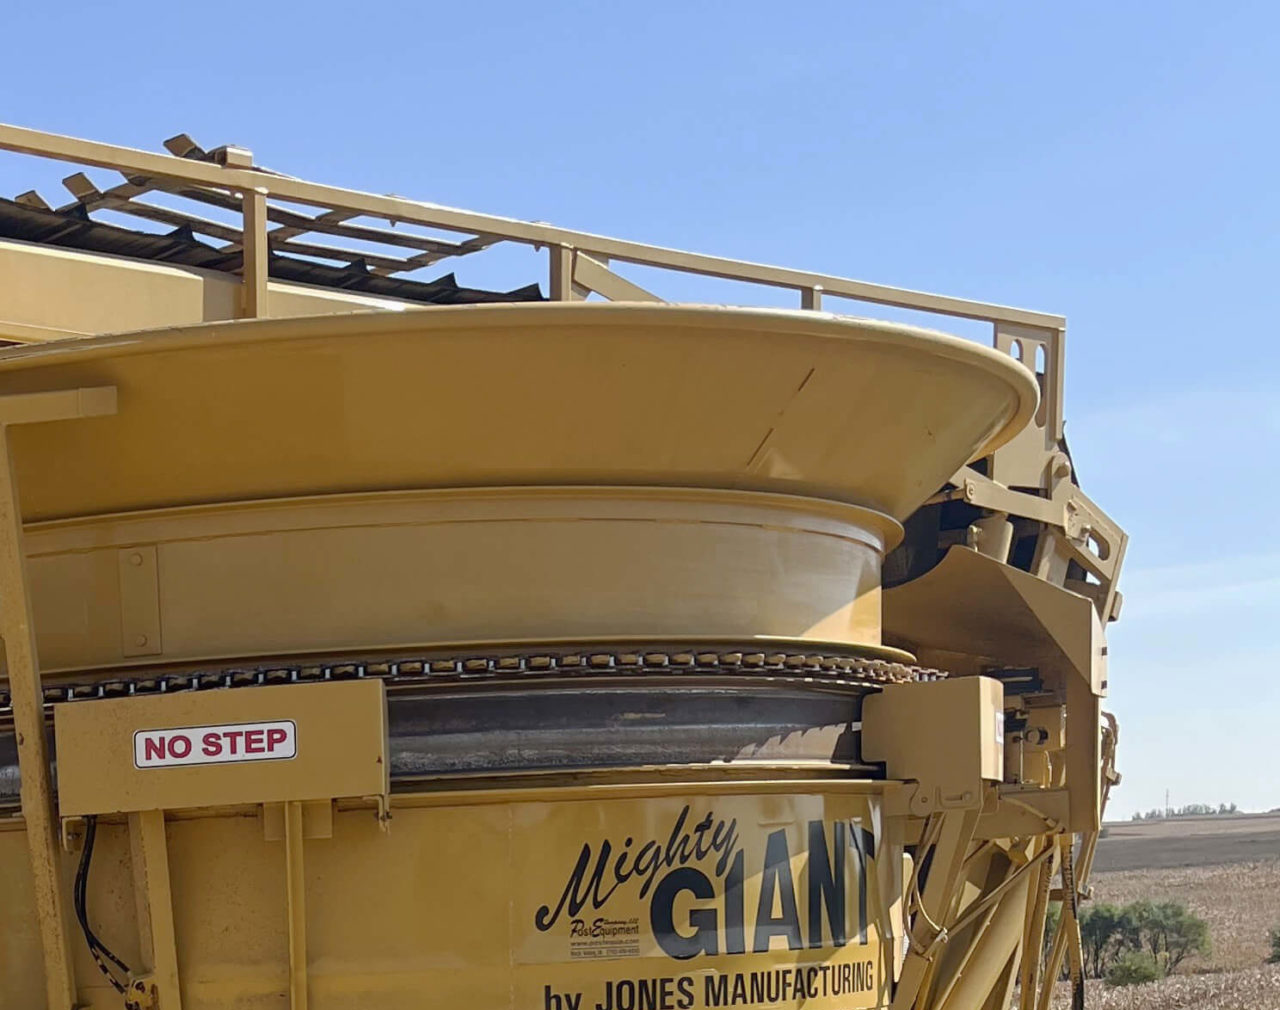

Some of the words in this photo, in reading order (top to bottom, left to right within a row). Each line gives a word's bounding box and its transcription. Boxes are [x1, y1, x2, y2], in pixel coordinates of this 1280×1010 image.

[145, 735, 192, 760] NO
[202, 728, 287, 756] STEP
[535, 805, 739, 932] Mighty
[650, 819, 875, 960] GIANT
[705, 960, 874, 1007] MANUFACTURING
